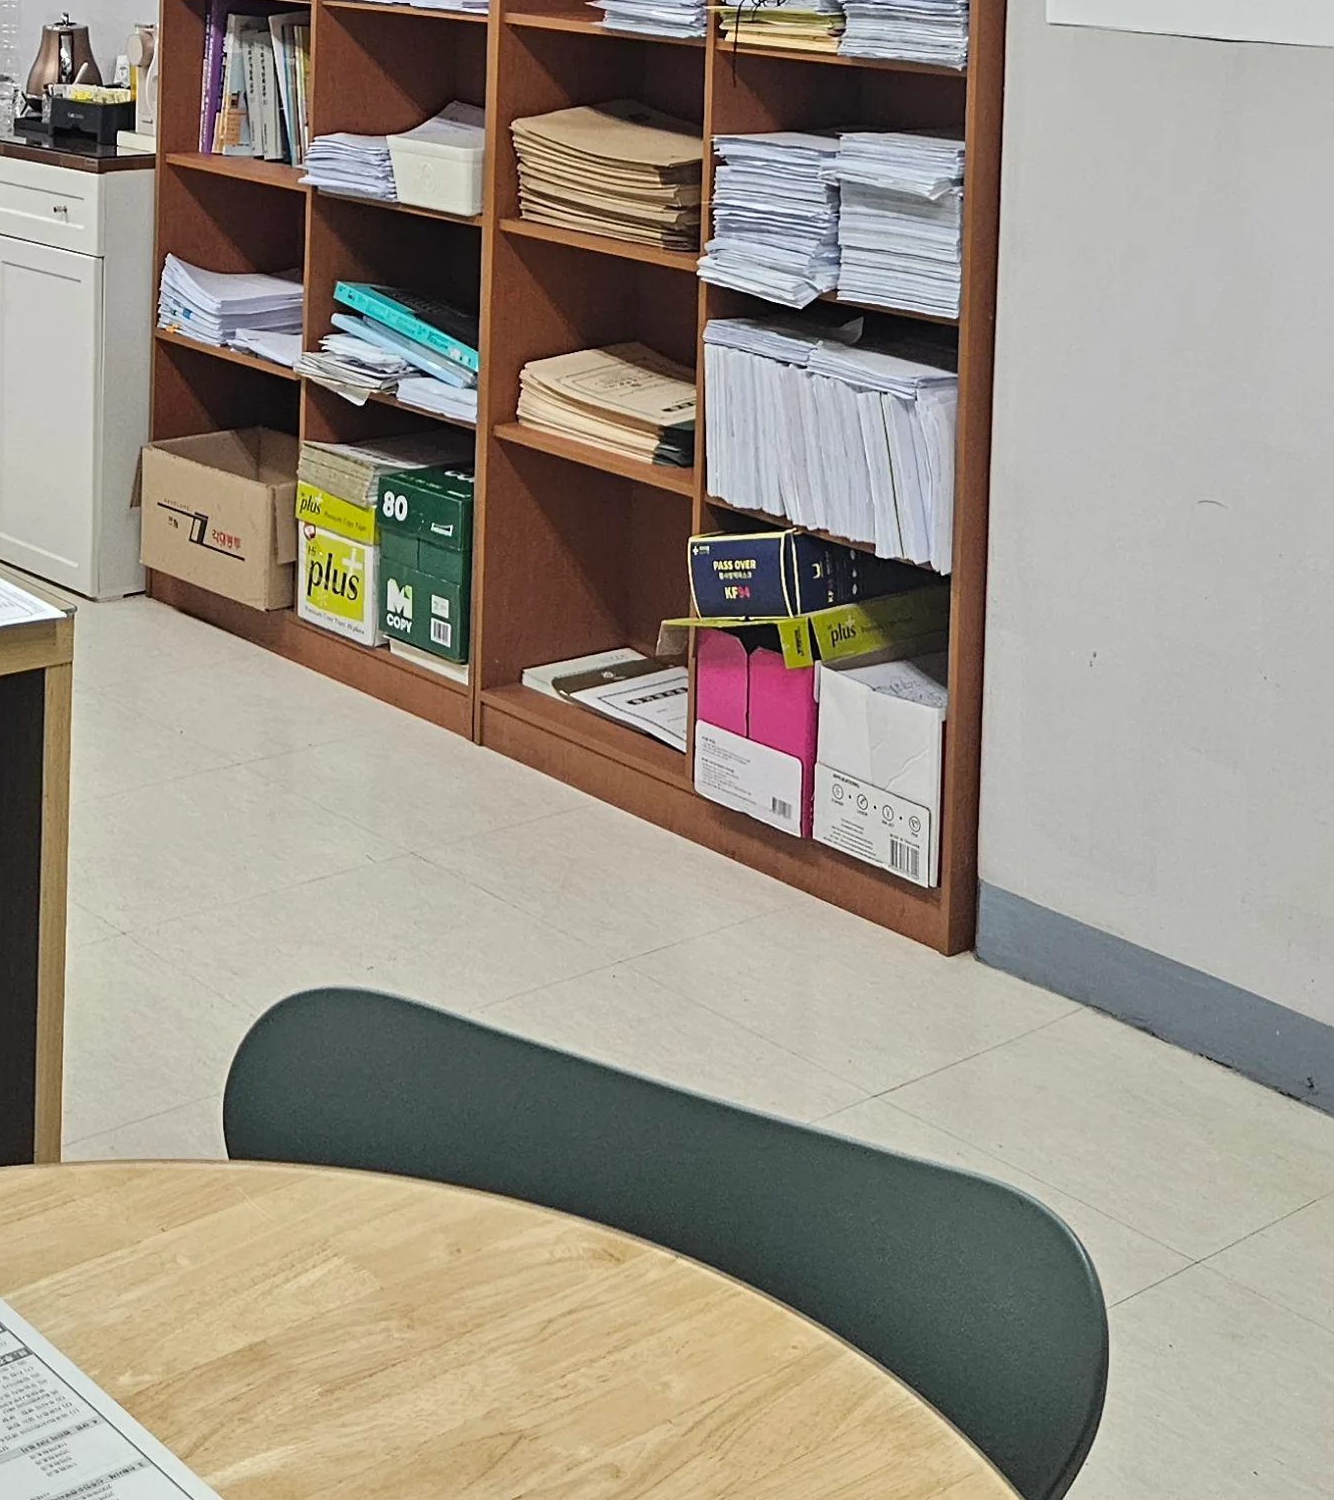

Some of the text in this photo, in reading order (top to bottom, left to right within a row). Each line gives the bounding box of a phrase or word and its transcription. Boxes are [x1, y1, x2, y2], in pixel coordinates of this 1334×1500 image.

[299, 494, 322, 516] plus
[343, 517, 354, 528] Copy
[382, 490, 408, 522] 80
[306, 552, 360, 601] plus
[712, 559, 757, 572] PASS OVER
[386, 577, 413, 620] M
[723, 584, 751, 600] KF94
[386, 613, 413, 635] COPY
[830, 622, 857, 648] plus
